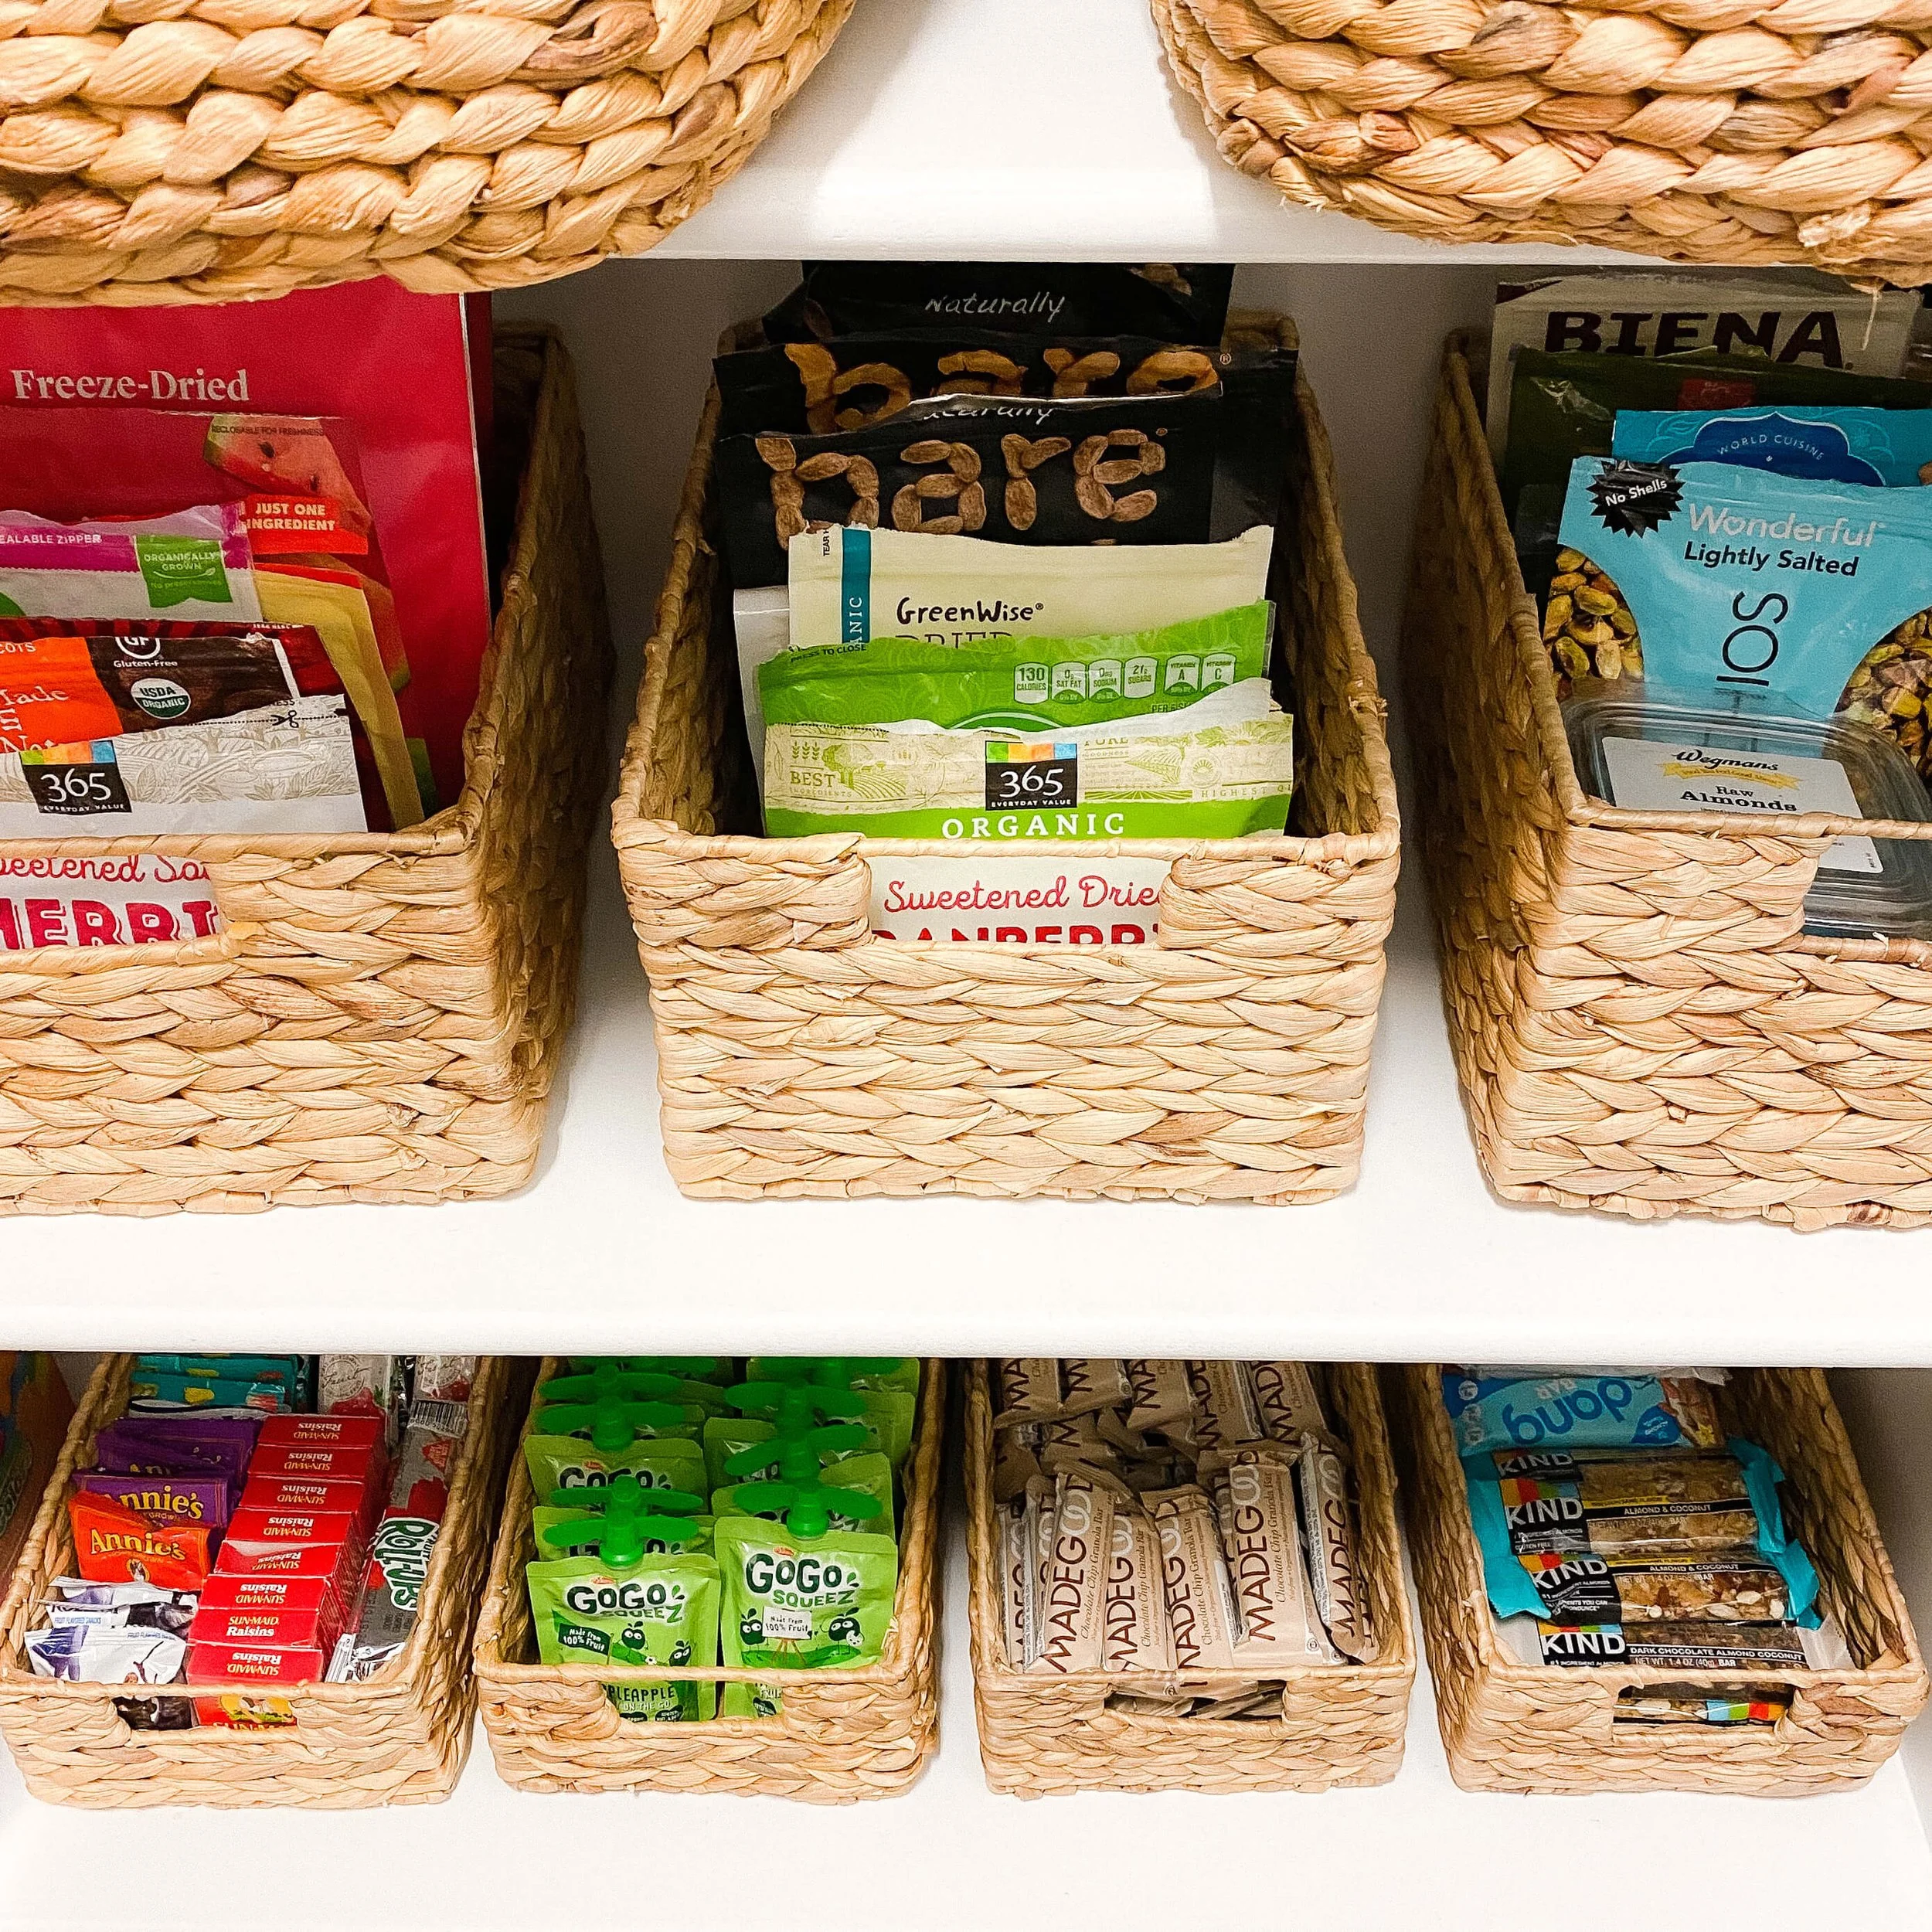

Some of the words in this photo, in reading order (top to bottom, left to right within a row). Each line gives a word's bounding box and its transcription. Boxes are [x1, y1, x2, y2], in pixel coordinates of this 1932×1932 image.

[9, 368, 250, 402] Freeze-Dried
[1717, 434, 1767, 454] WORLD
[1774, 434, 1825, 461] CUISINE
[1605, 492, 1626, 507] No
[1628, 478, 1668, 501] Shells
[256, 503, 289, 515] JUST
[294, 504, 325, 516] ONE
[246, 518, 335, 532] INGREDIENT
[1689, 503, 1878, 547] Wonderful
[57, 534, 102, 544] ZIPPER
[162, 562, 202, 571] GROWN
[1684, 541, 1770, 572] Lightly
[1778, 549, 1859, 577] Salted
[896, 597, 1034, 624] GreenWise
[822, 648, 835, 656] TO
[837, 643, 867, 654] CLOSE
[114, 659, 178, 668] Gluten-Free
[1019, 667, 1045, 682] 130
[1178, 668, 1185, 681] A
[1215, 668, 1222, 680] C
[1056, 679, 1068, 688] SAT
[1070, 679, 1082, 688] FAT
[140, 687, 176, 698] USDA
[144, 697, 185, 709] ORGANIC
[1672, 750, 1779, 771] Wegmans
[40, 767, 111, 802] 365
[791, 770, 836, 788] BEST
[999, 764, 1064, 798] 365
[790, 787, 852, 798] INGREDIENTS
[1202, 786, 1268, 798] HIGHEST
[1716, 785, 1753, 797] Raw
[1680, 791, 1798, 812] Almonds
[942, 813, 1124, 839] ORGANIC
[884, 875, 1070, 913] Sweetened
[1502, 1379, 1633, 1445] dang
[298, 1422, 342, 1431] Raisins
[294, 1431, 340, 1440] SUN-MAID
[288, 1452, 333, 1461] Raisins
[1497, 1453, 1573, 1477] KIND
[284, 1461, 332, 1471] SUN-MAID
[281, 1485, 327, 1495] Raisins
[1263, 1471, 1273, 1492] Bar
[104, 1485, 204, 1519] nnie's
[277, 1495, 326, 1505] SUN-MAID
[1094, 1507, 1104, 1528] Bar
[1267, 1491, 1278, 1529] Granola
[1504, 1498, 1583, 1529] KIND
[1624, 1507, 1661, 1515] ALMOND
[1669, 1504, 1712, 1513] COCONUT
[268, 1517, 314, 1527] Raisins
[1183, 1517, 1192, 1536] Bar
[263, 1527, 311, 1537] SUN-MAID
[1135, 1527, 1145, 1546] Bar
[90, 1529, 186, 1560] Annie's
[1090, 1527, 1102, 1566] Granola
[1270, 1529, 1281, 1553] Chip
[257, 1552, 301, 1563] Raisins
[1185, 1536, 1199, 1574] Granola
[1136, 1546, 1146, 1582] Granola
[1087, 1564, 1097, 1588] Chip
[1271, 1553, 1285, 1603] Chocolate
[1530, 1559, 1608, 1589] KIND
[240, 1583, 287, 1594] Raisins
[1139, 1581, 1151, 1603] Chip
[1192, 1574, 1204, 1596] Chip
[235, 1594, 286, 1604] SUN-MAID
[228, 1616, 279, 1625] SUN-MAID
[770, 1615, 786, 1624] Made
[1080, 1587, 1095, 1639] Chocolate
[1197, 1594, 1213, 1645] Chocolate
[226, 1626, 274, 1637] Raisins
[1141, 1602, 1151, 1648] Chocolate
[563, 1635, 585, 1645] 100%
[586, 1638, 605, 1651] Fruit
[1539, 1633, 1626, 1655] KIND
[232, 1652, 282, 1665] Raisins
[1635, 1658, 1651, 1666] NET
[1718, 1658, 1736, 1667] BAR
[1658, 1648, 1715, 1656] CHOCOLATE
[1716, 1650, 1756, 1658] ALMOND
[1757, 1652, 1804, 1662] COCONUT
[226, 1663, 281, 1675] SUN-MAID
[657, 1701, 669, 1709] GO
